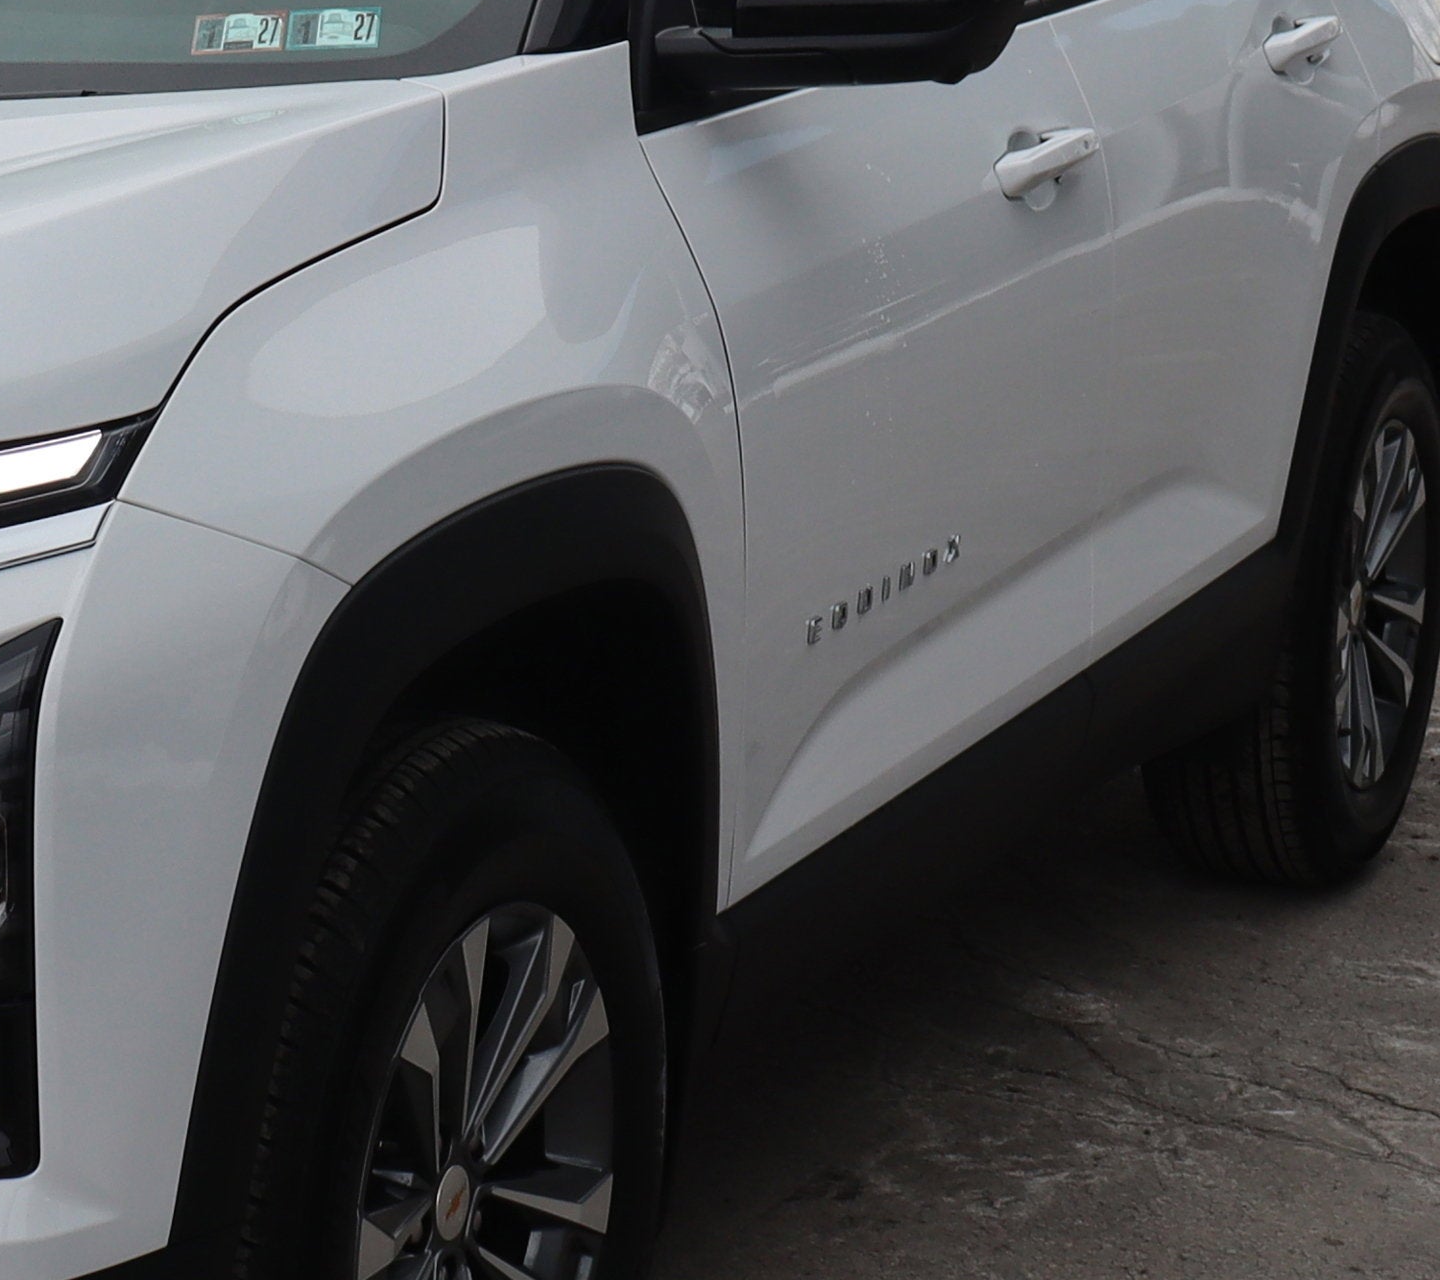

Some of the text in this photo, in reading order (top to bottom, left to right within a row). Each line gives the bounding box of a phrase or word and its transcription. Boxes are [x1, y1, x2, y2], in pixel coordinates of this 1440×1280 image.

[257, 17, 281, 45] 27
[353, 13, 377, 43] 27
[805, 534, 961, 646] EQUINOX
